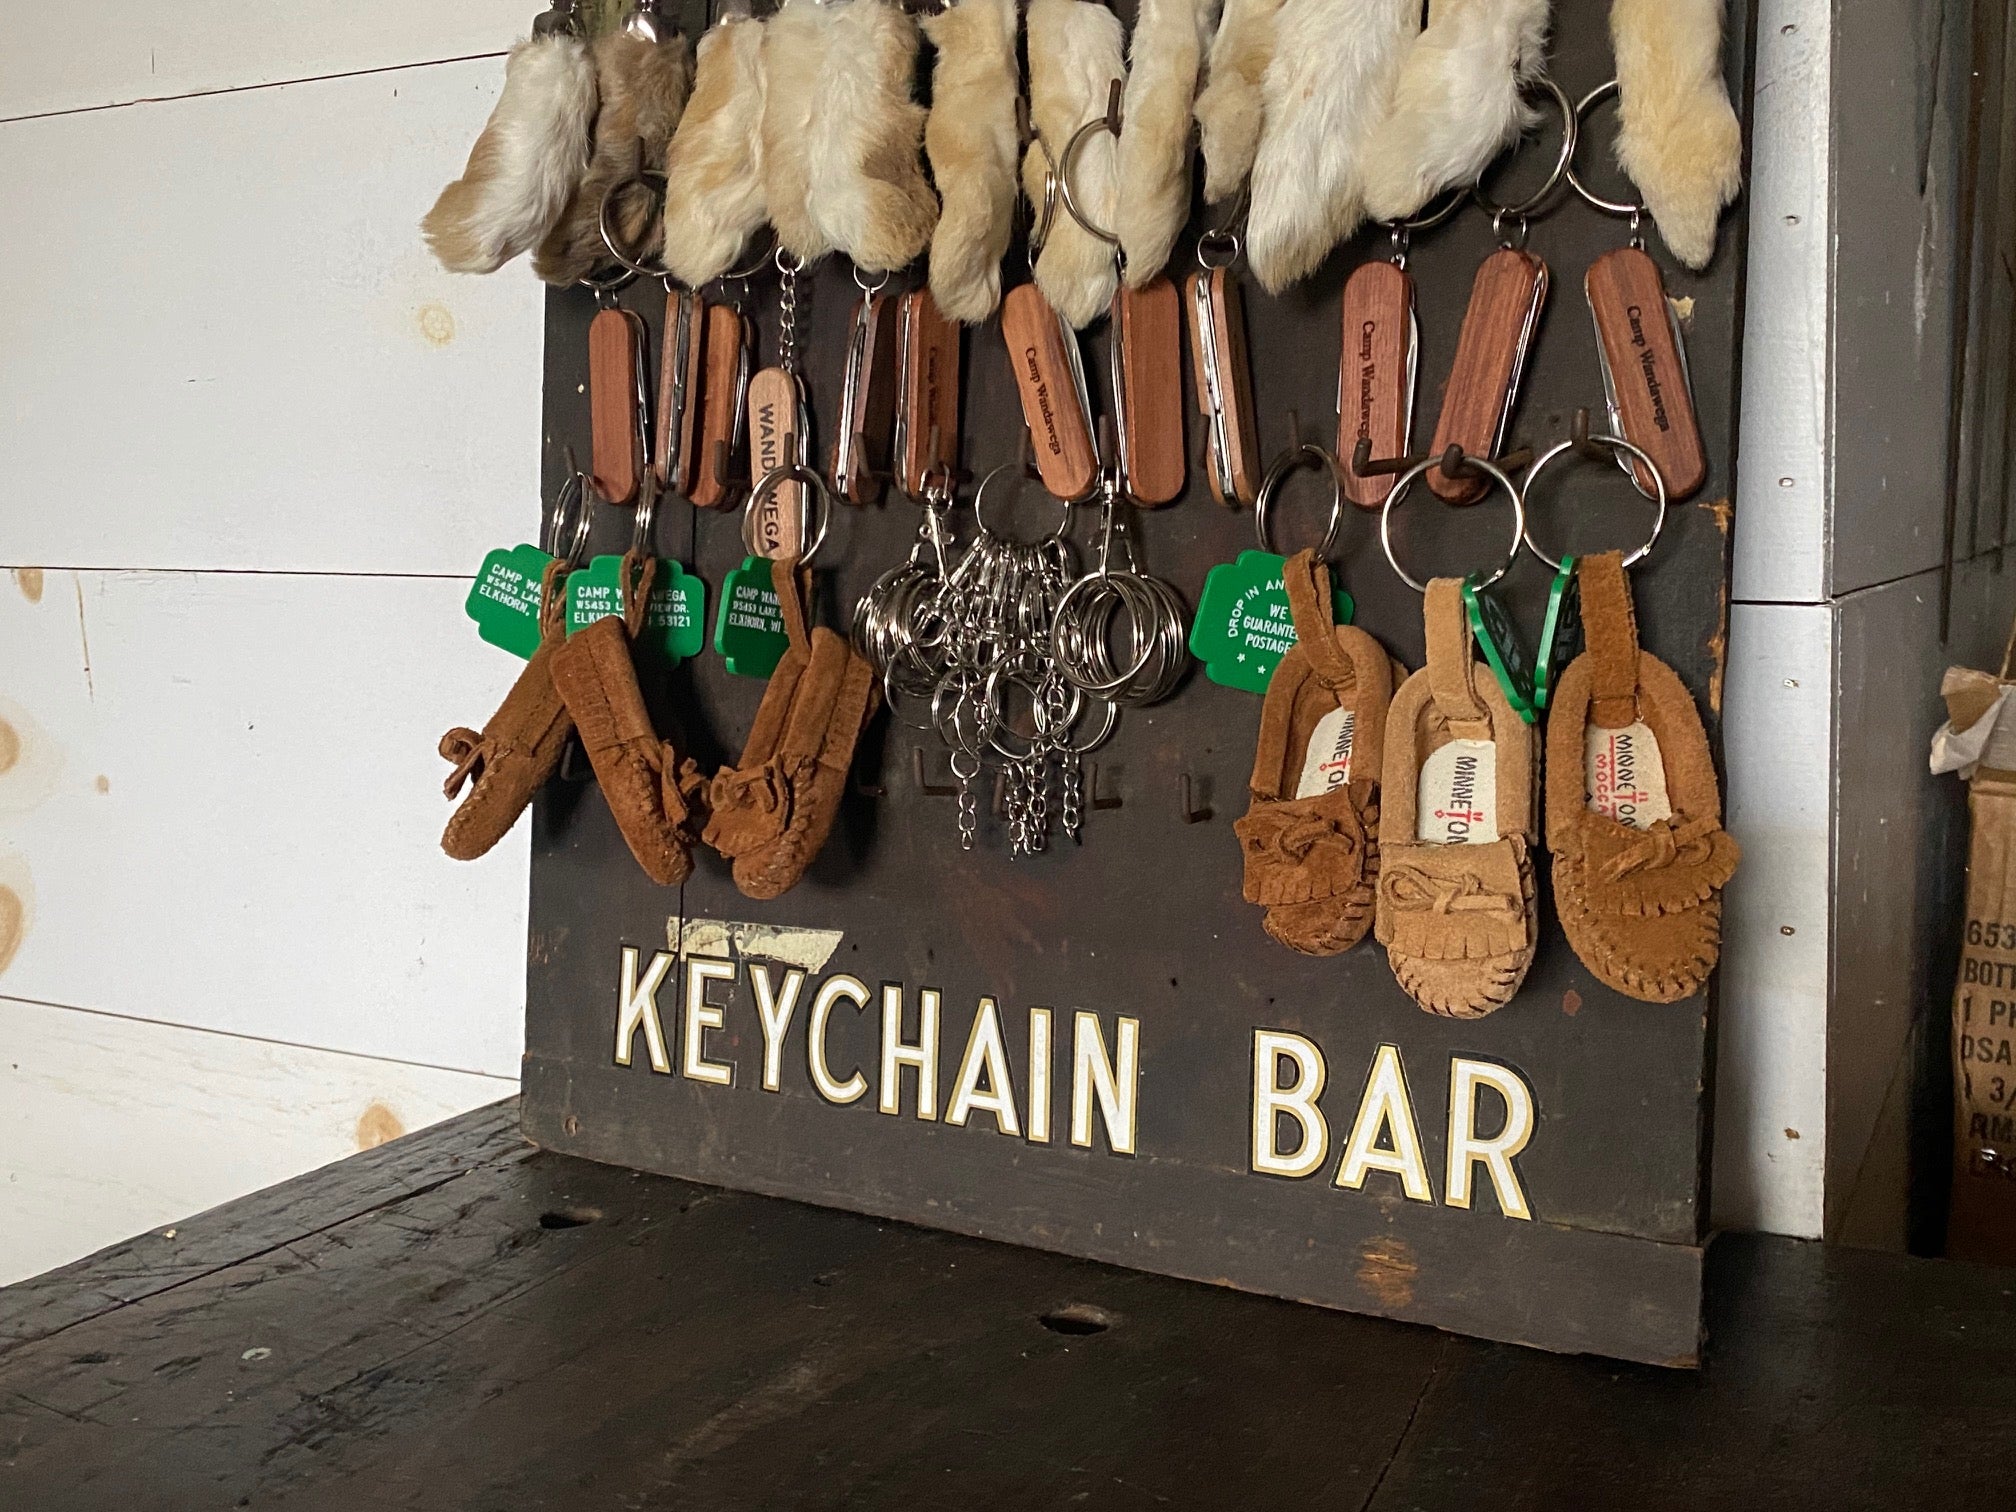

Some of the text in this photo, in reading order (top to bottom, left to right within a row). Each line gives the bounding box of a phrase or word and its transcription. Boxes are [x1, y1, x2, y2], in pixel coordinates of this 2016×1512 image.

[1627, 305, 1669, 432] Camp Wandawega
[1357, 321, 1375, 440] Camp Wandaweg
[1025, 347, 1061, 456] Camp Wandawega
[492, 563, 522, 583] CAMP
[521, 590, 541, 606] LAK
[577, 586, 610, 599] CAMP
[736, 585, 758, 601] CAMP
[1228, 579, 1285, 638] DROP IN AN
[1269, 603, 1289, 620] WE
[659, 615, 691, 628] 53121
[614, 946, 1535, 1221] KEYCHAIN BAR
